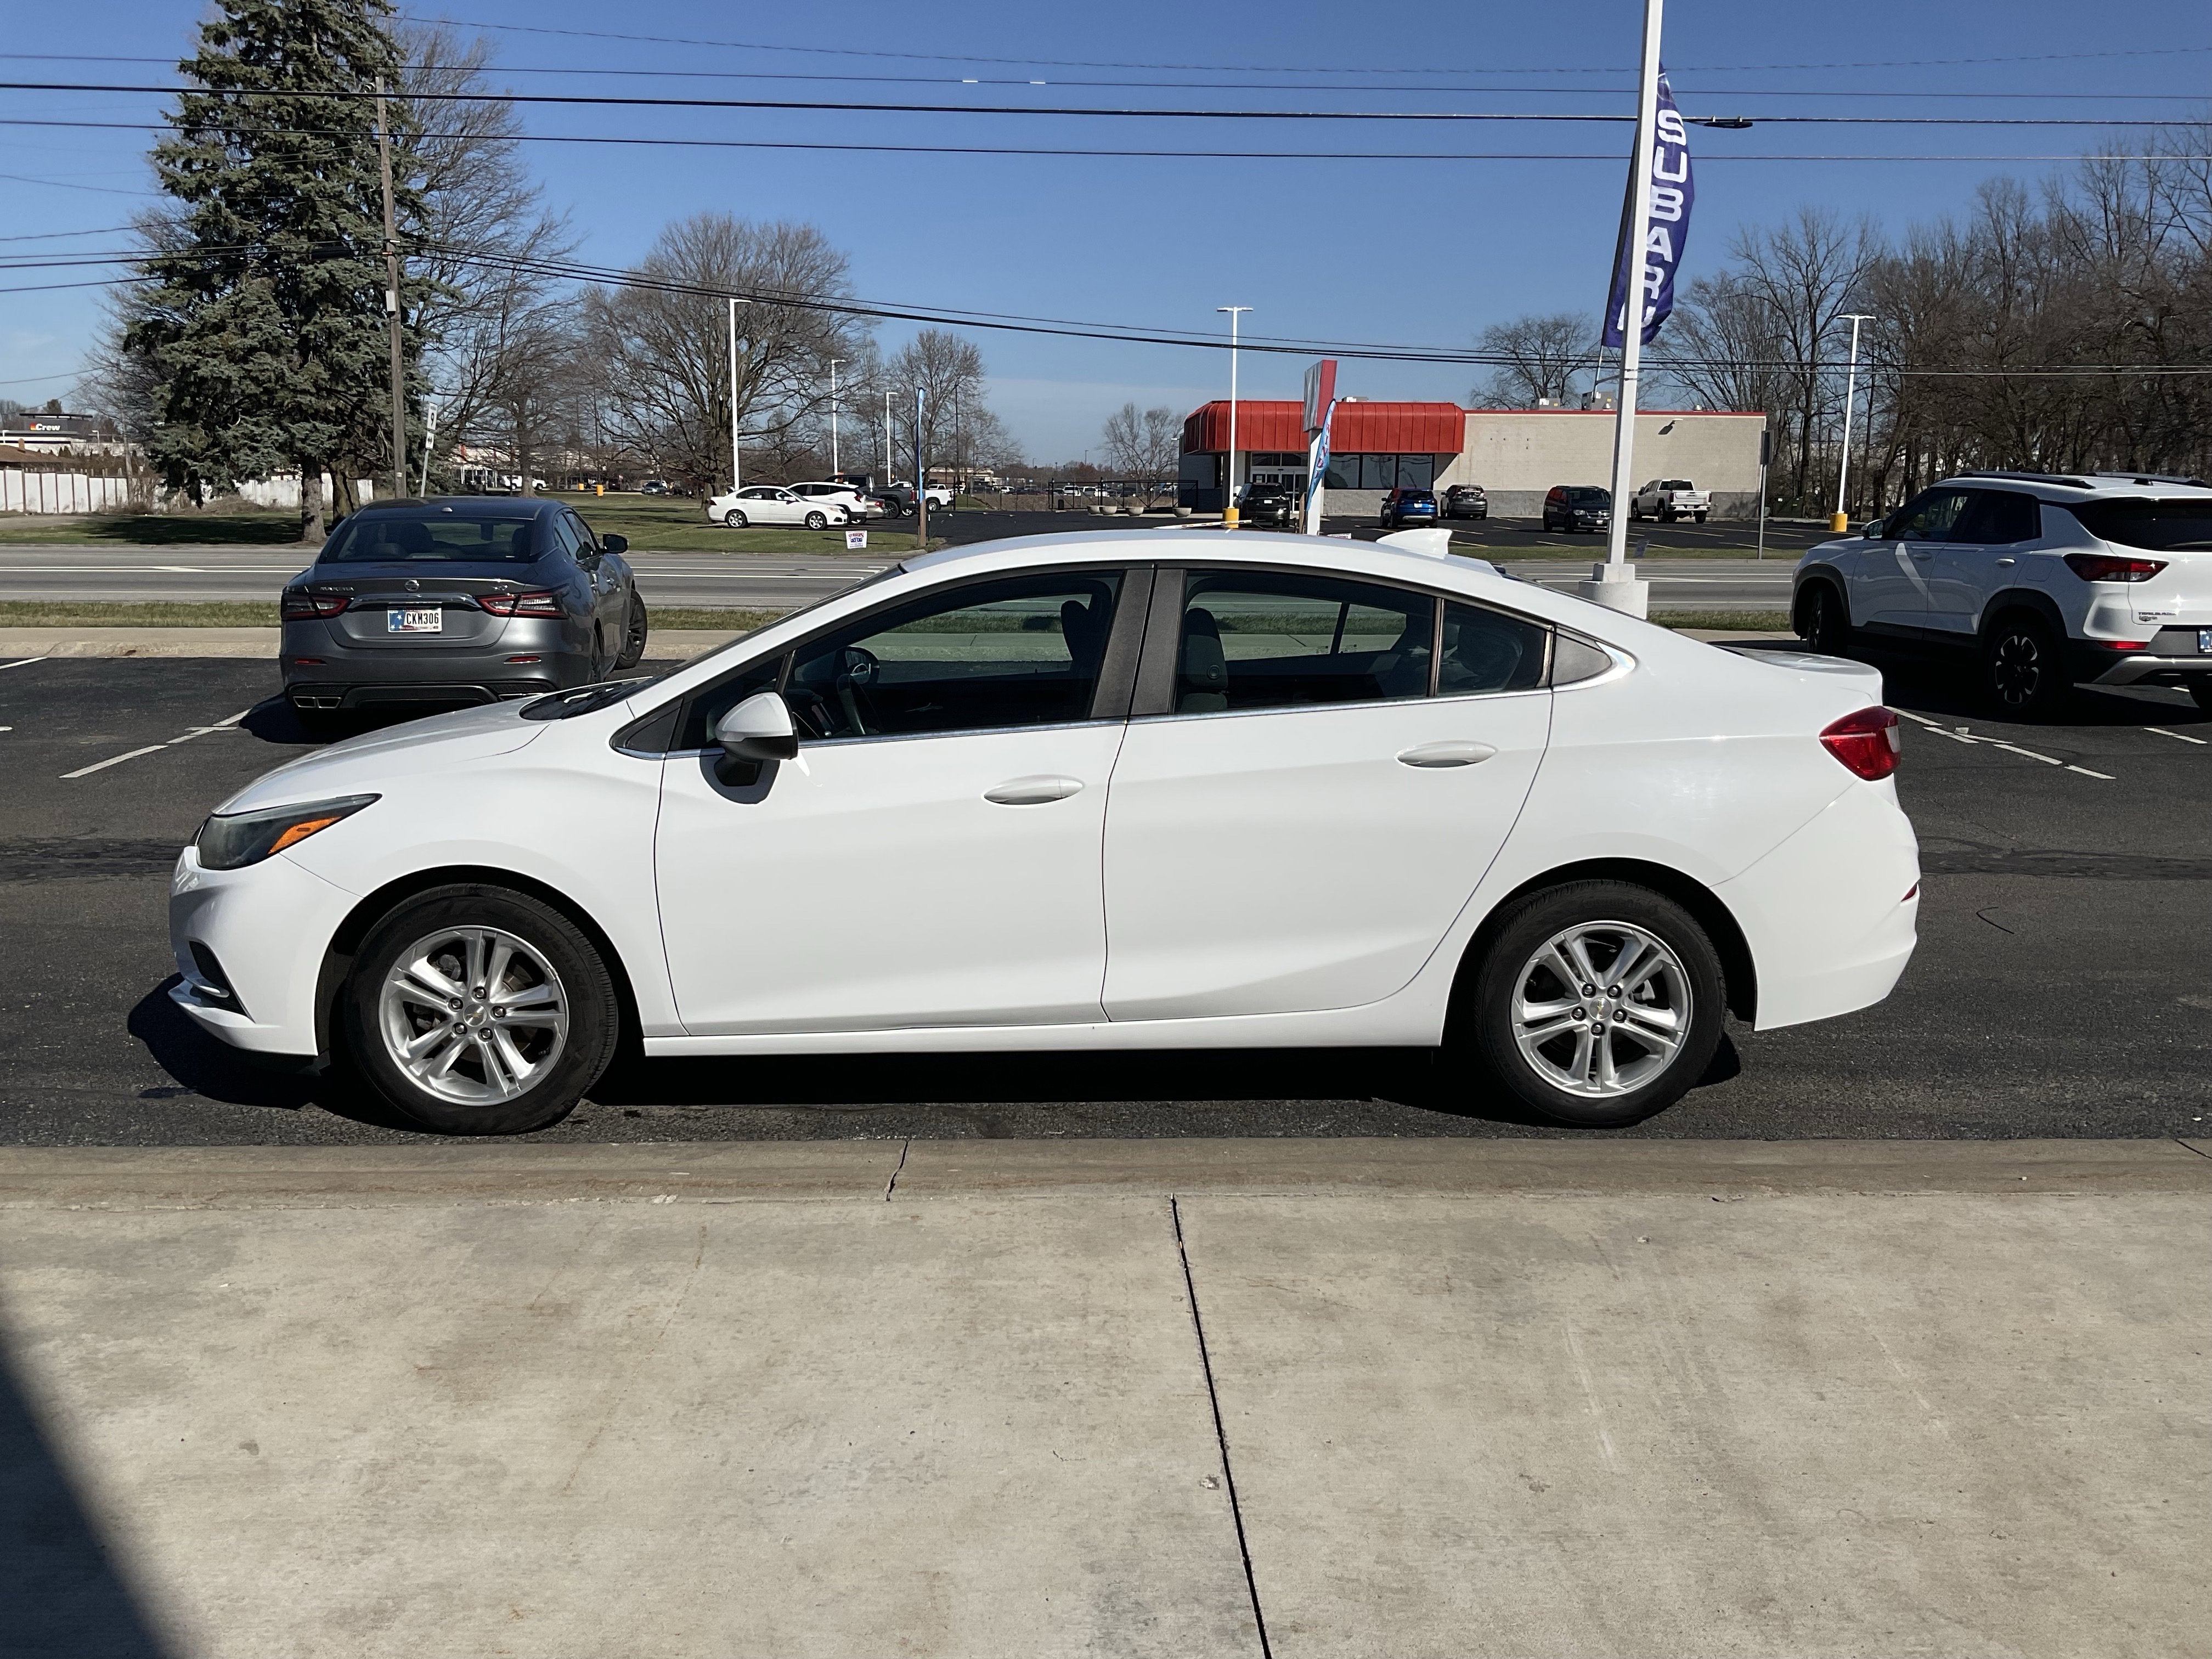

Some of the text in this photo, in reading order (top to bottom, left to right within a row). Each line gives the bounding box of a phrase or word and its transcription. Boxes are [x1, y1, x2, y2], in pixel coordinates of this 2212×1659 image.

[1617, 110, 1686, 330] SUBARU
[431, 412, 435, 426] 9
[407, 613, 439, 625] CKM306
